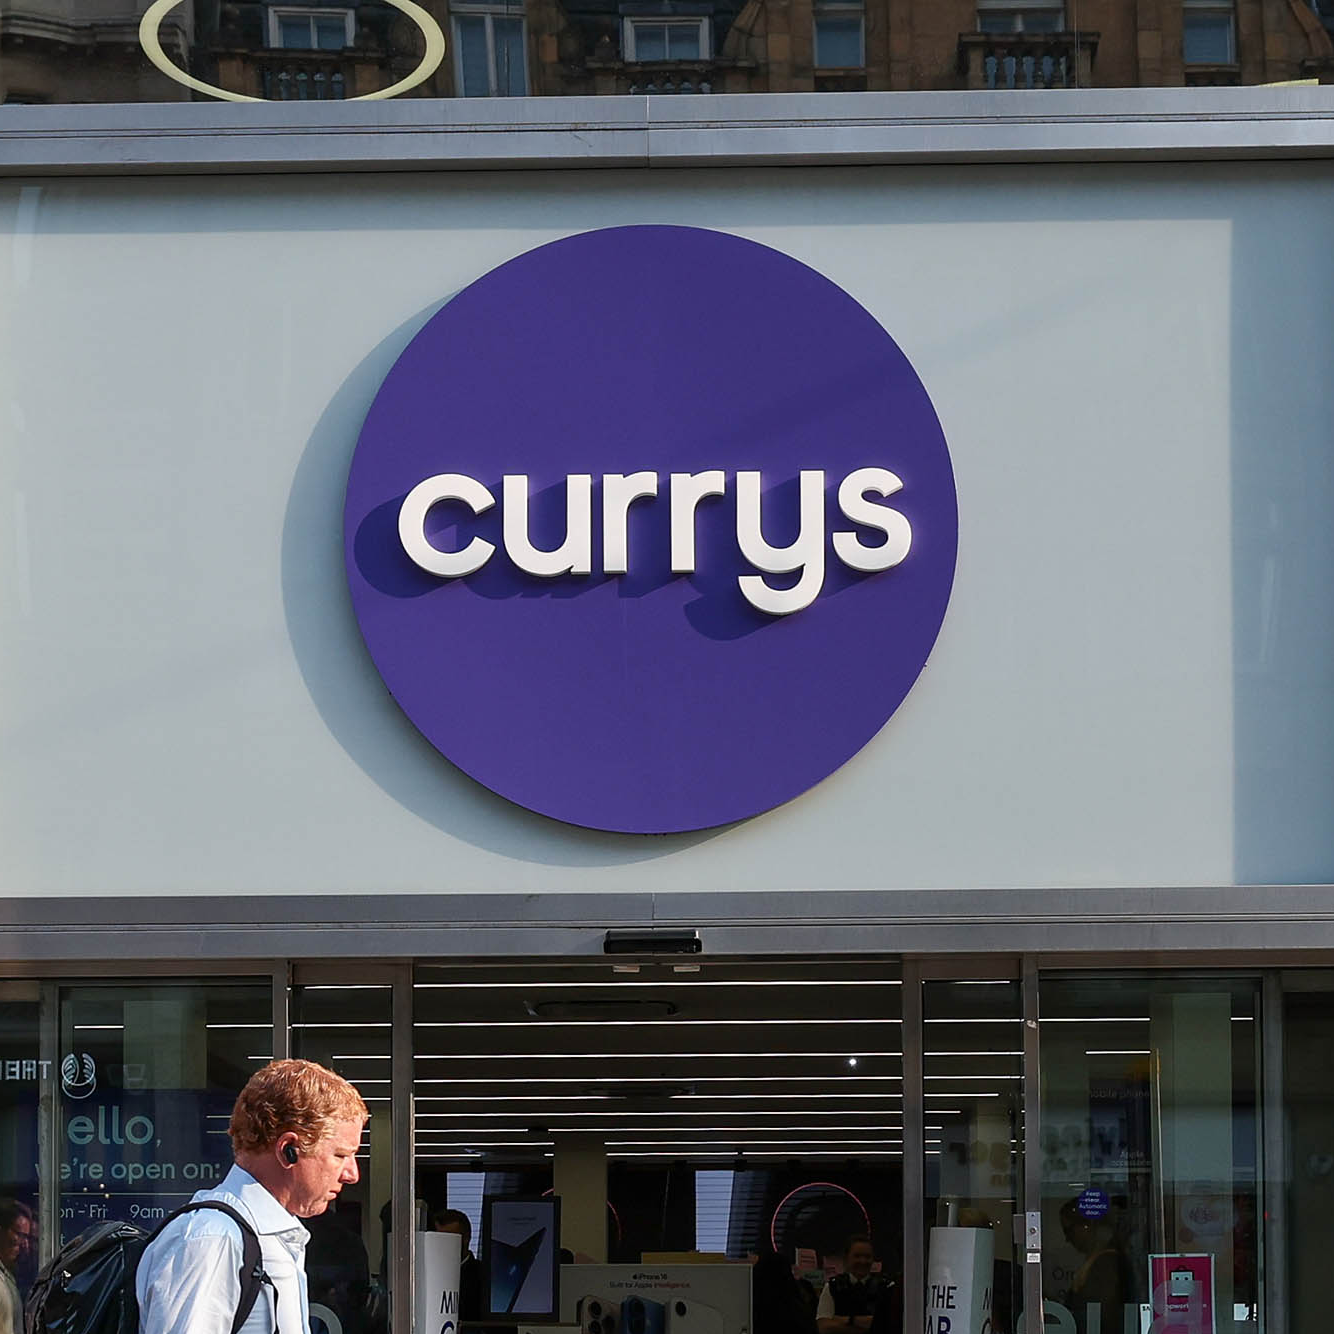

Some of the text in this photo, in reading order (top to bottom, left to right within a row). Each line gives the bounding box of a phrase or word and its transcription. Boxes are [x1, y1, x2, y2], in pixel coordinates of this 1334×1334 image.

[398, 467, 912, 616] currys
[66, 1105, 162, 1148] ello,
[60, 1157, 220, 1184] e're open on:
[89, 1205, 107, 1219] Fri
[130, 1205, 164, 1219] 9am
[931, 1285, 957, 1310] THE
